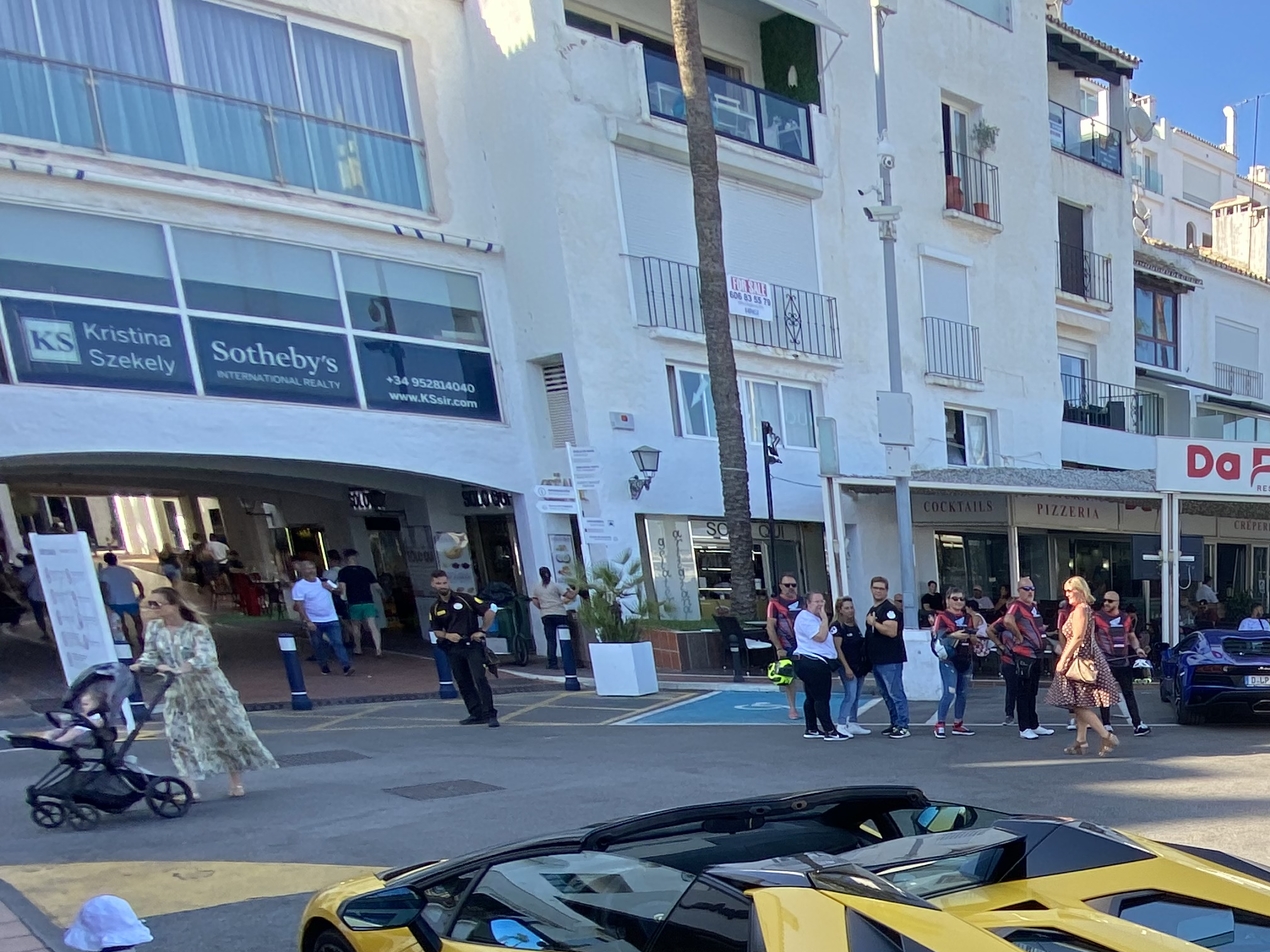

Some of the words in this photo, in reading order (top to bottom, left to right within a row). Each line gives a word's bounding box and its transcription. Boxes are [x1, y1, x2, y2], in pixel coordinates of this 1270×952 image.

[732, 277, 747, 292] FOR
[748, 280, 767, 296] SALE
[30, 329, 75, 354] KS
[82, 321, 172, 348] Kristina
[89, 349, 176, 376] Szekely
[211, 340, 339, 376] Sotheby's
[216, 370, 302, 387] INTERNATIONAL
[303, 378, 341, 390] REALTY
[386, 375, 410, 387] +34
[411, 377, 476, 394] 952814040
[389, 391, 478, 409] www.KSsir.com
[1187, 444, 1241, 481] Da
[923, 500, 994, 514] COCKTAILS
[1037, 503, 1100, 519] PIZZERIA
